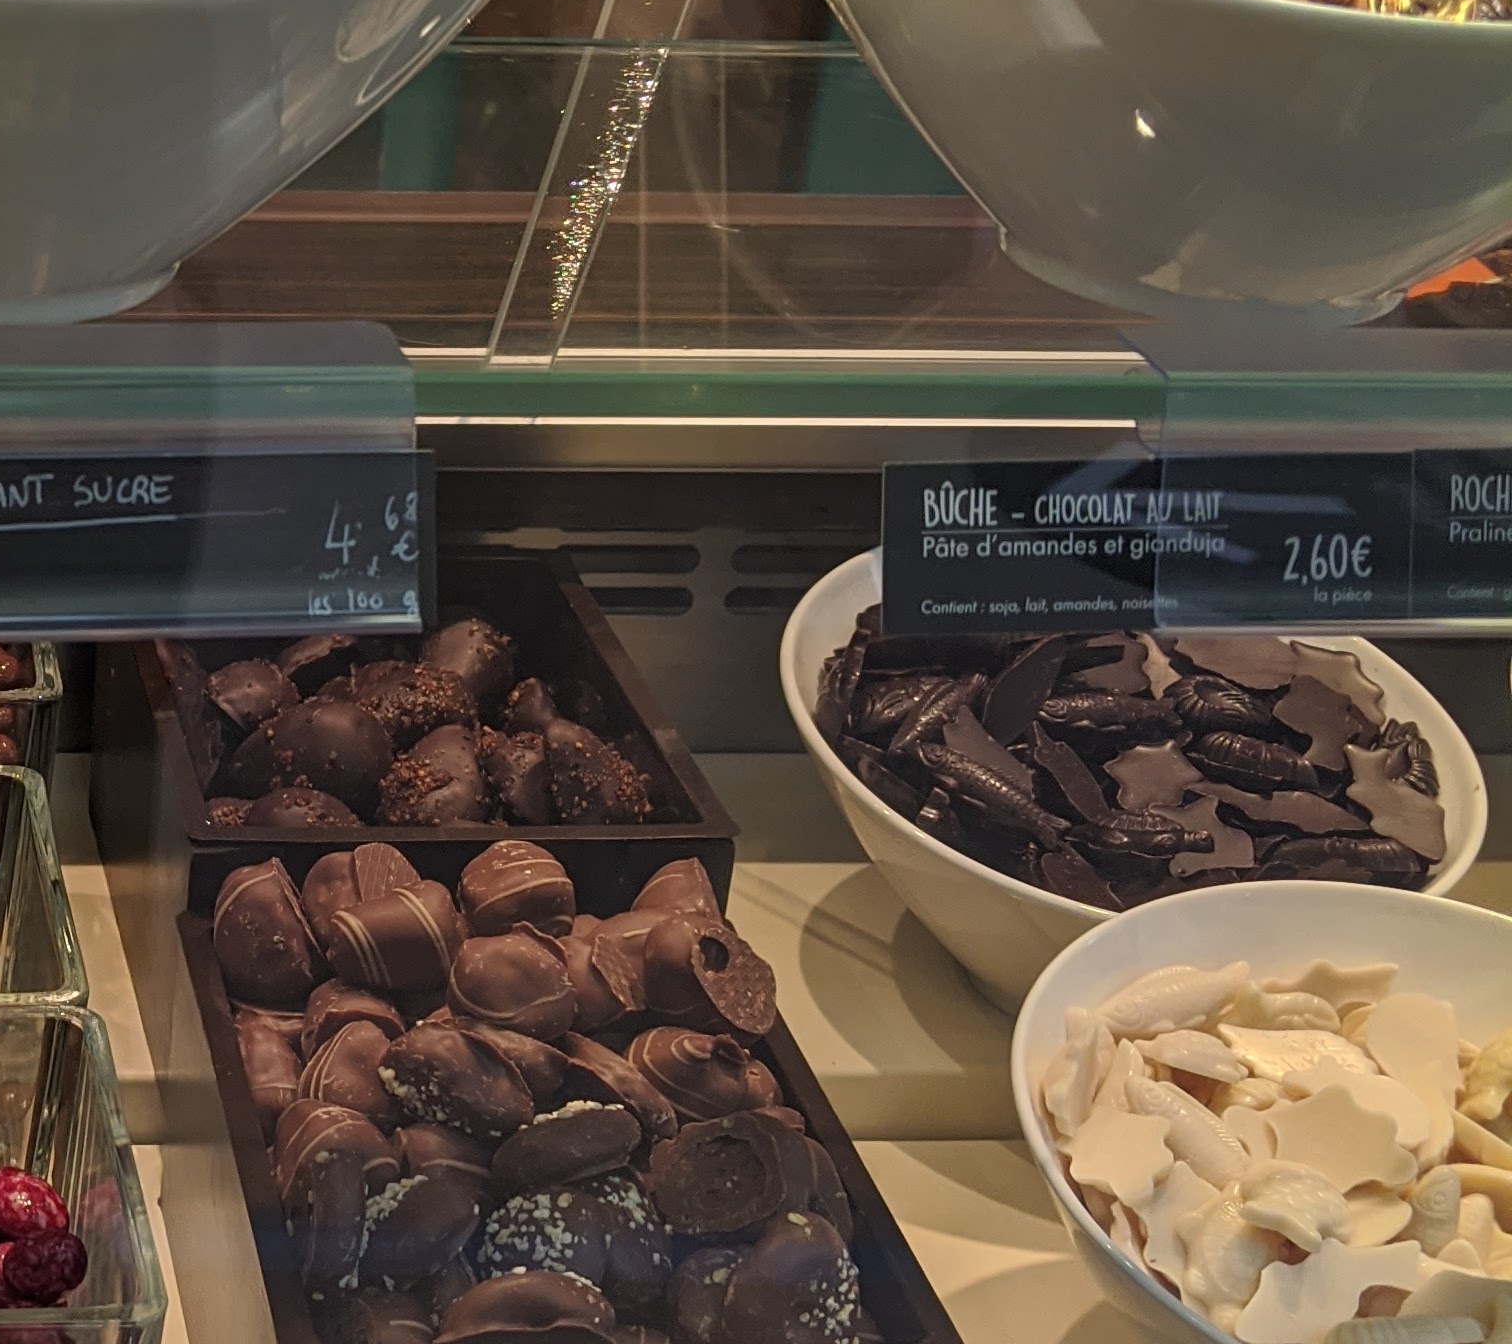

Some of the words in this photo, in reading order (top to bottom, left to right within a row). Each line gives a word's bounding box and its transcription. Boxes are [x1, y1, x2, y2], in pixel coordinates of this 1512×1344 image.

[74, 473, 175, 508] SUCRE
[923, 480, 998, 527] BÛCHE
[1034, 491, 1136, 526] CHOCOLAT
[1146, 491, 1172, 523] AU
[1184, 491, 1223, 523] LAIT
[922, 534, 970, 558] Pâte
[975, 532, 1097, 558] d'amandes
[1104, 535, 1125, 556] et
[1130, 531, 1227, 562] gianduja
[1281, 533, 1373, 587] 2,60€
[921, 597, 979, 615] Contient
[989, 599, 1020, 619] soja,
[1025, 596, 1050, 615] lait,
[1053, 596, 1119, 615] amandes,
[1313, 586, 1327, 602] la
[1330, 585, 1373, 606] pièce
